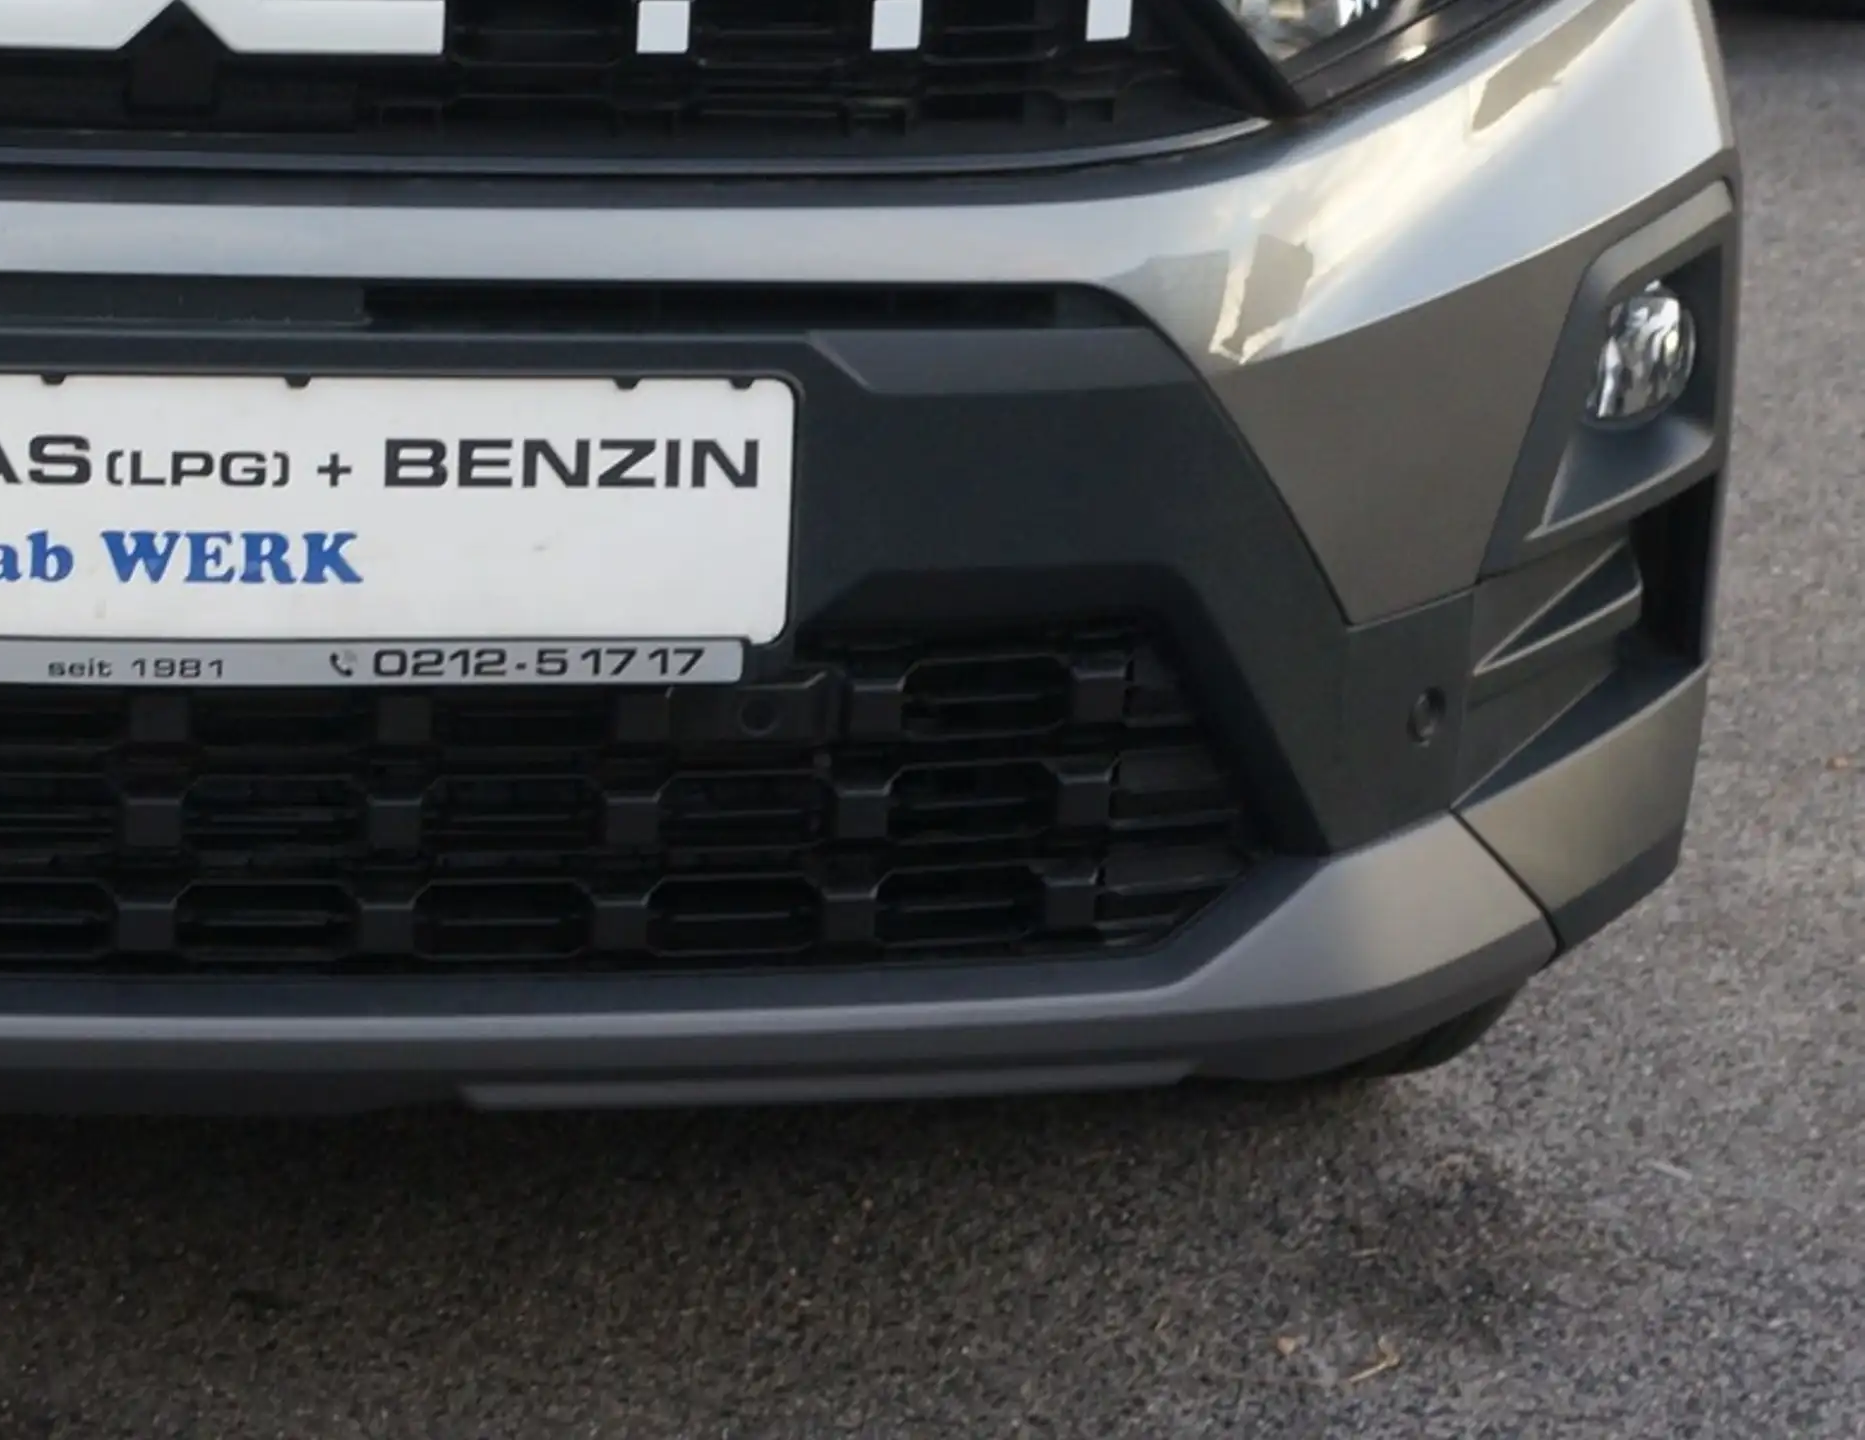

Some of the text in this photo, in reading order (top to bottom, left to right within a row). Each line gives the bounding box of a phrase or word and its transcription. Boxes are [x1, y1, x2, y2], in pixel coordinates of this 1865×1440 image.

[316, 452, 353, 488] +
[383, 437, 760, 489] BENZIN
[101, 530, 361, 585] WERK
[47, 657, 224, 680] seit 1981
[372, 647, 705, 678] 0212-51717
